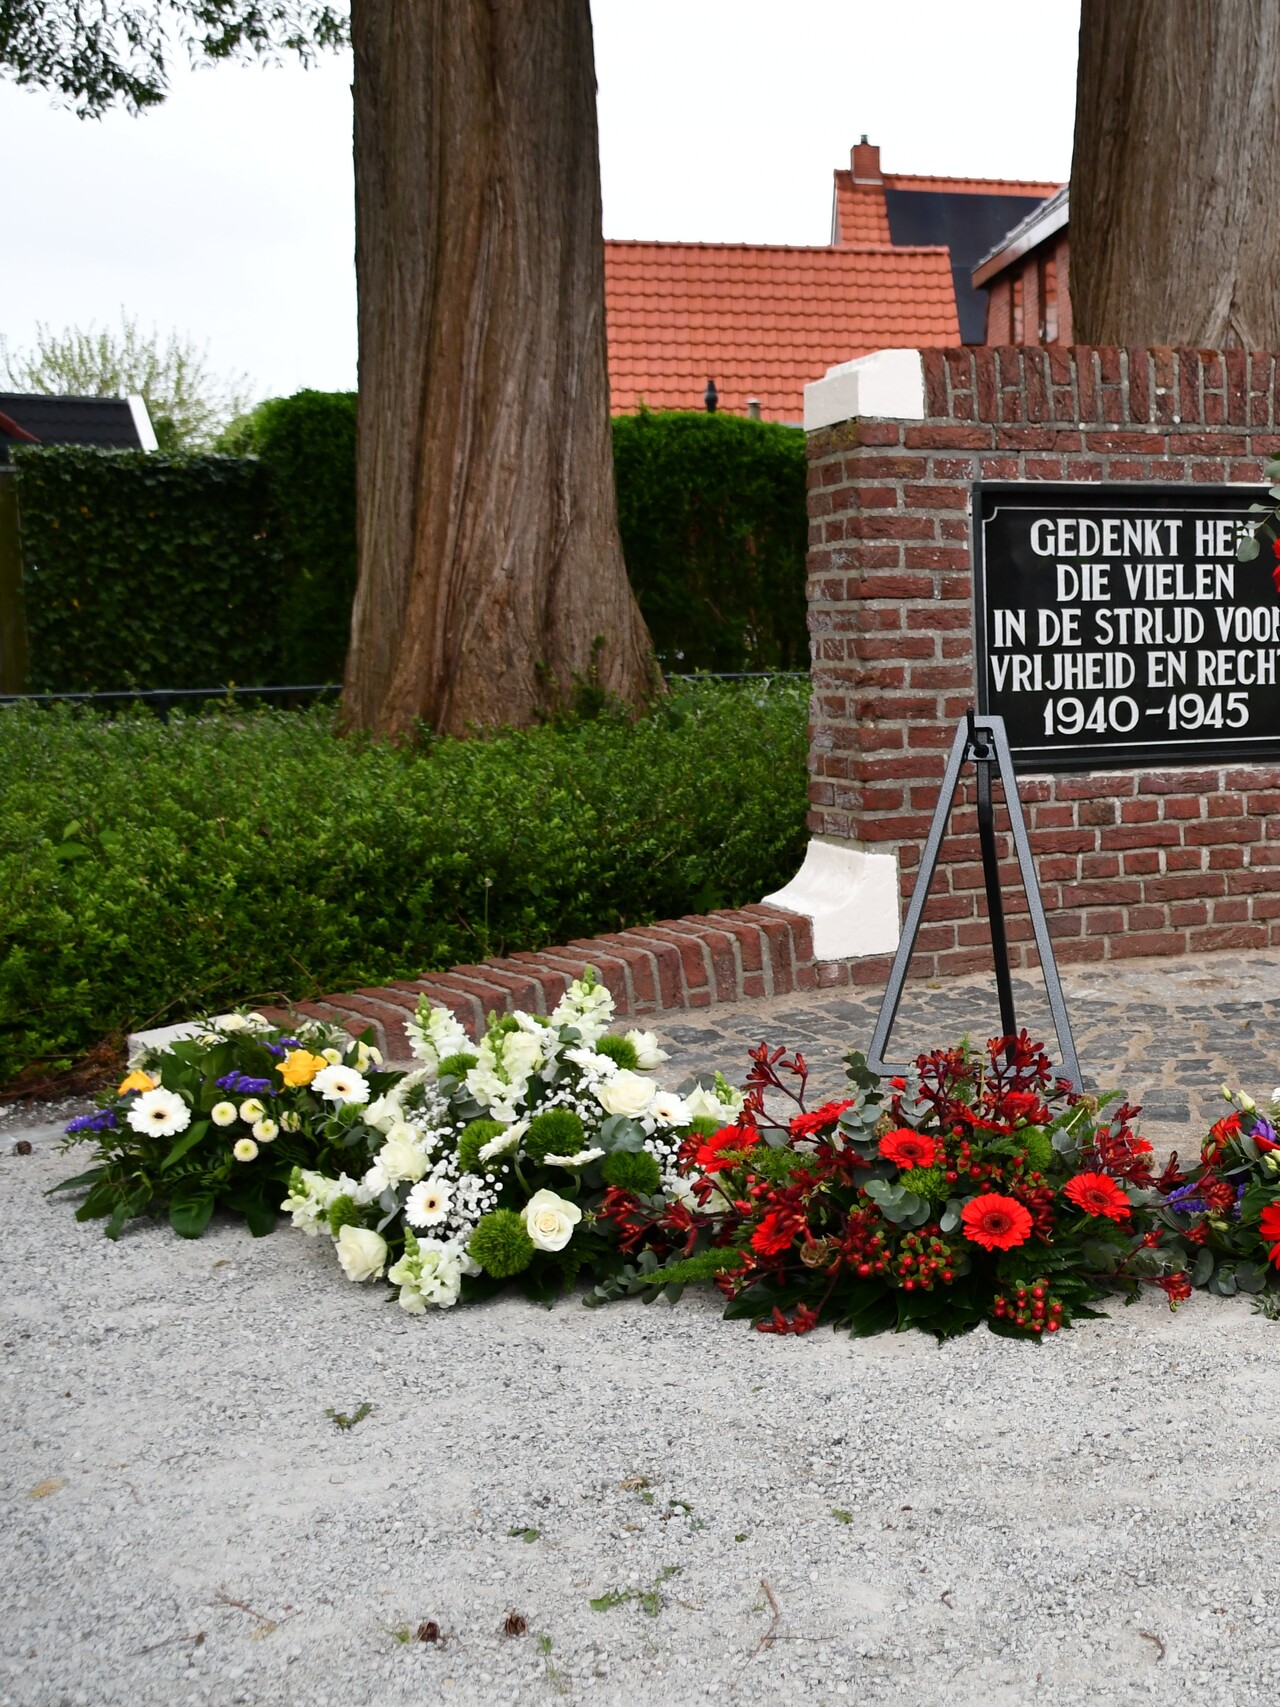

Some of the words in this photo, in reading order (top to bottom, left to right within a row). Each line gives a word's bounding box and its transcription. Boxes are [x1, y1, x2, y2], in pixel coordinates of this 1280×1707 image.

[1030, 518, 1182, 557] GEDENKT
[1055, 563, 1111, 602] DIE
[1123, 563, 1235, 601] VIELEN
[993, 609, 1026, 648] IN
[1037, 608, 1082, 647] DE
[1094, 606, 1205, 645] STRIJD
[989, 651, 1136, 692] VRIJHEID
[1147, 650, 1187, 688] EN
